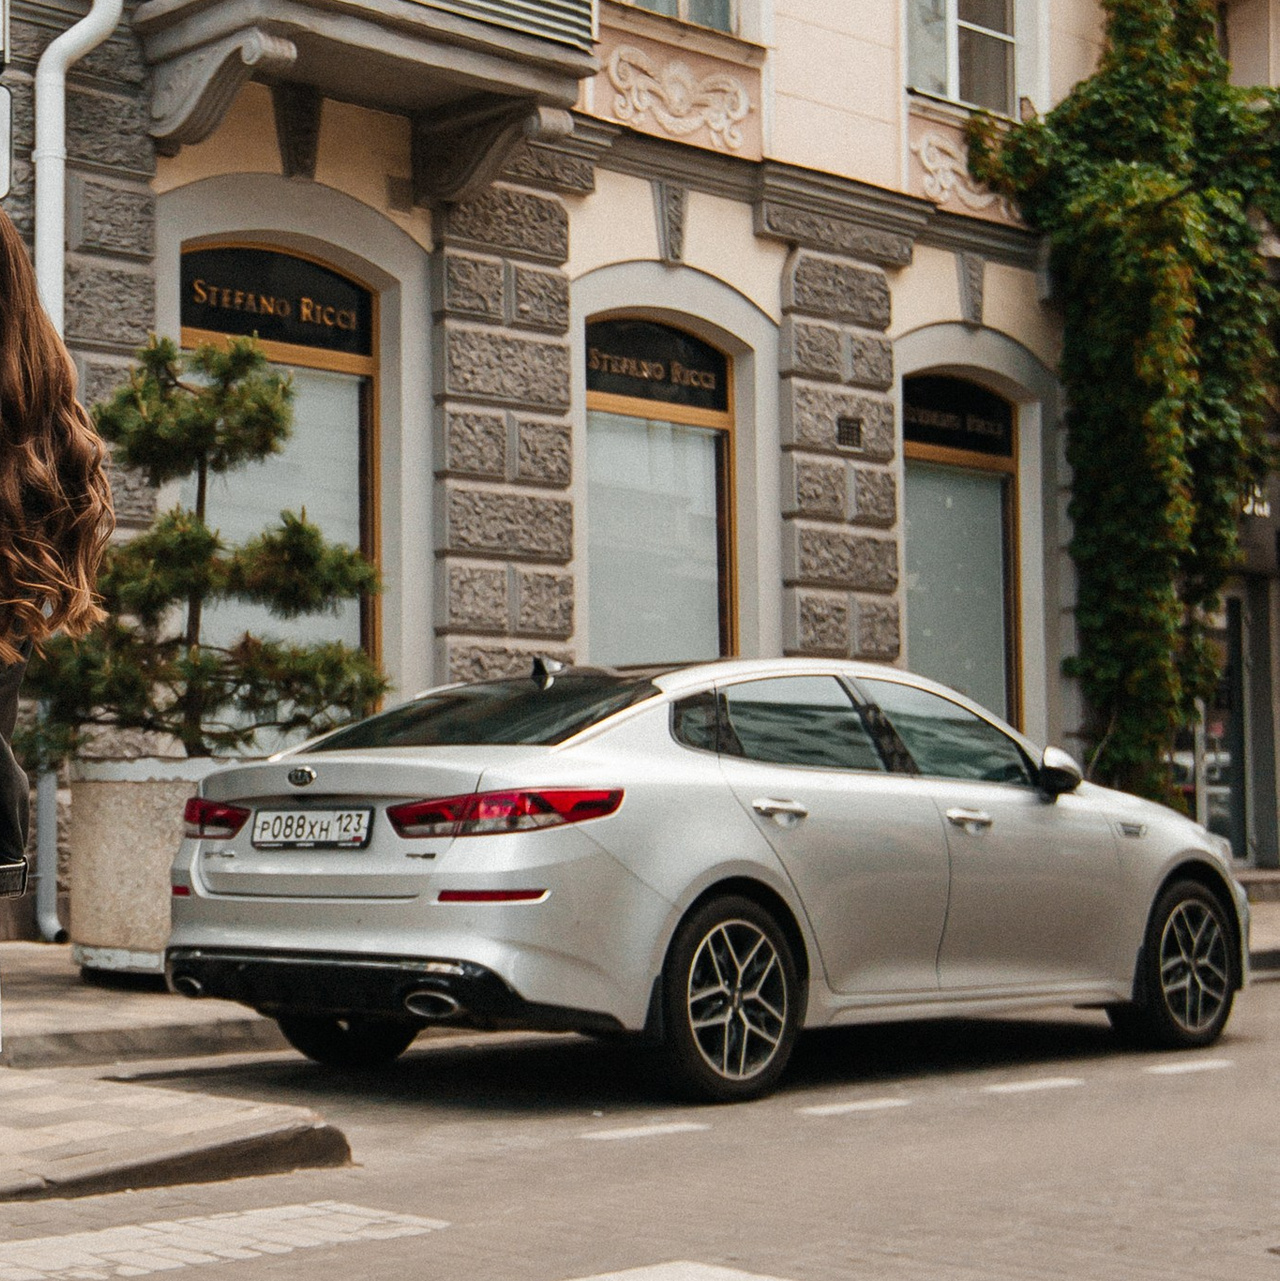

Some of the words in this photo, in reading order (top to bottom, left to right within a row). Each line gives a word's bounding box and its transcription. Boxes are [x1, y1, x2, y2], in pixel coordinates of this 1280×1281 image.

[192, 278, 292, 318] STEFANO
[300, 296, 357, 331] RICCI
[335, 813, 363, 833] 123
